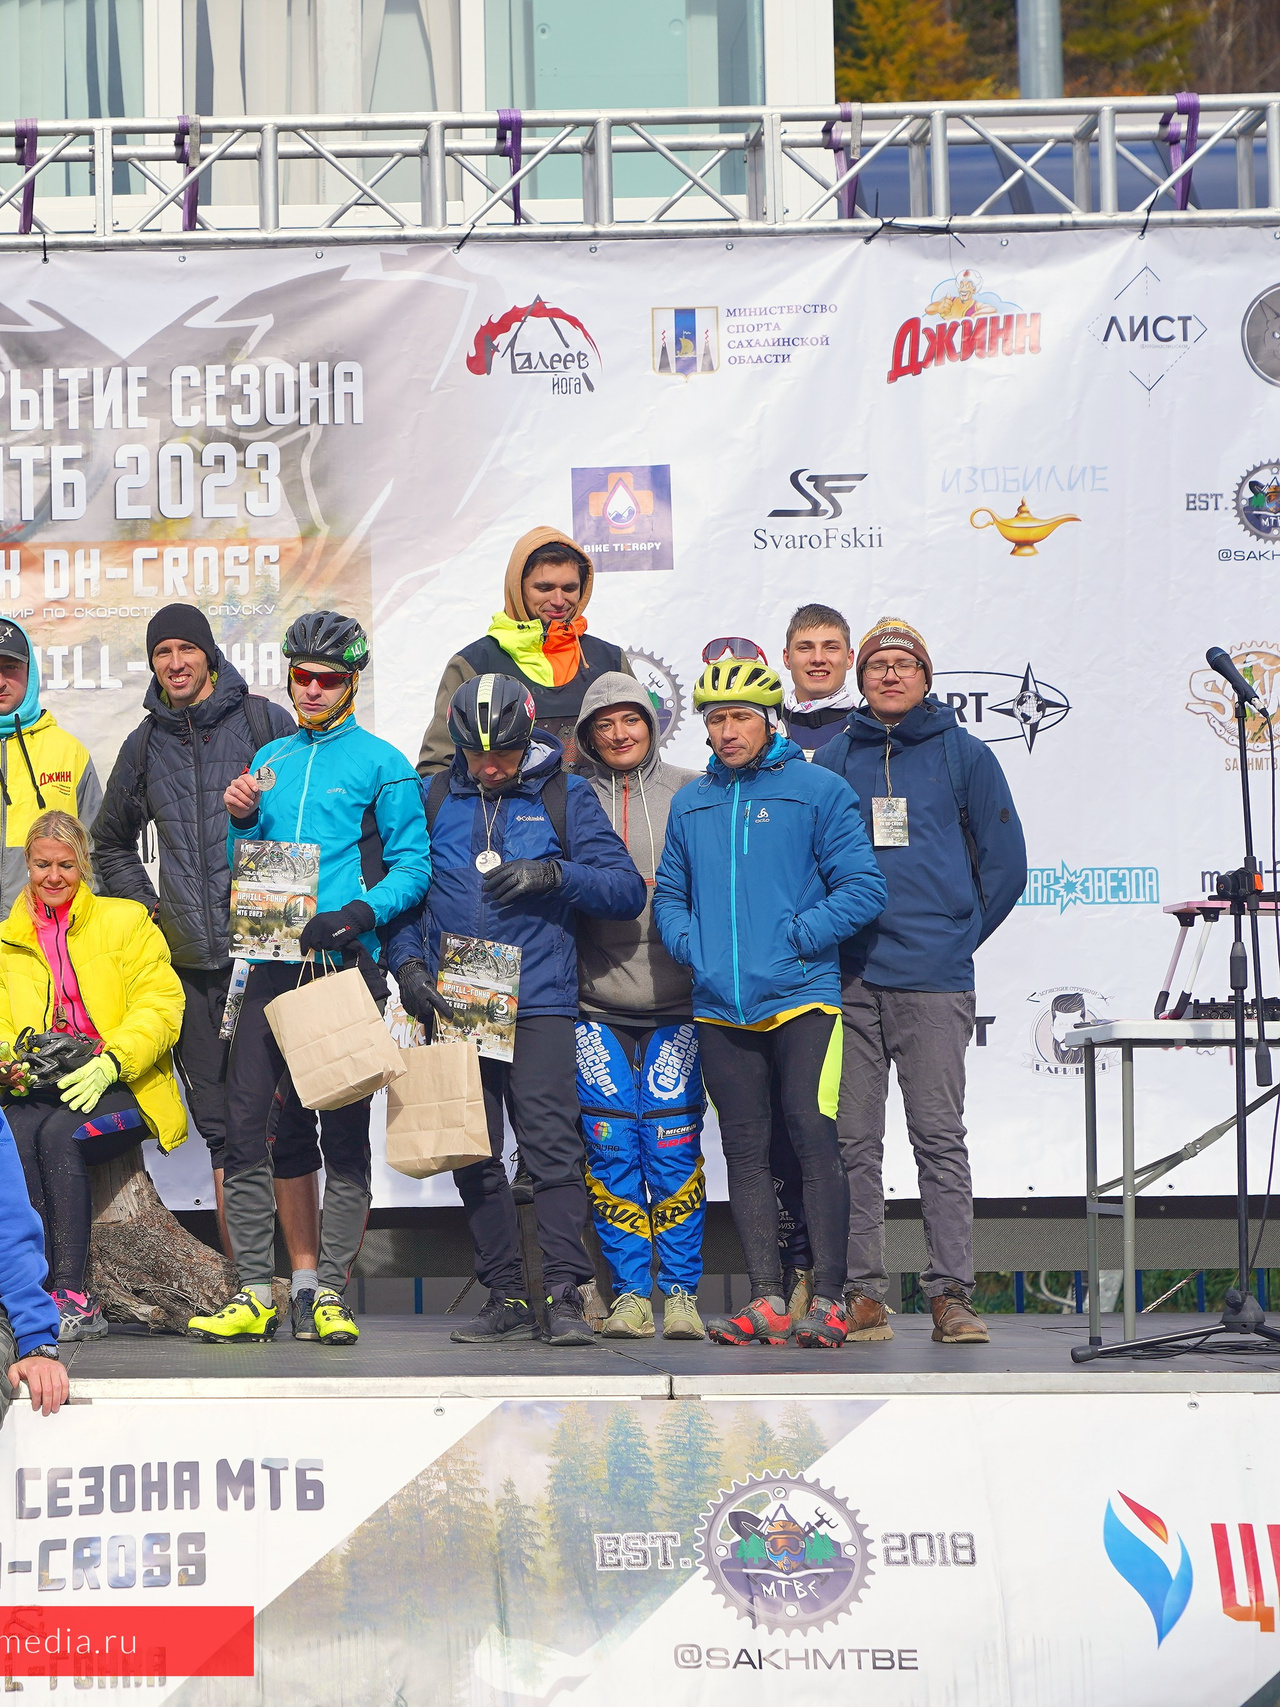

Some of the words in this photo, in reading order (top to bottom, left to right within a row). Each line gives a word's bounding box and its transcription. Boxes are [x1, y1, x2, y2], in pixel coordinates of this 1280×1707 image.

[725, 303, 838, 318] МИНИСТЕРСТВО
[727, 323, 781, 334] СПОРТА
[727, 334, 830, 347] САХАЛИНСКОЙ
[1102, 315, 1193, 342] ЛИСТ
[727, 353, 791, 366] ОБЛАСТИ
[886, 312, 1042, 384] ДЖИНН
[171, 361, 364, 428] СЕЗОНА
[115, 441, 282, 520] 2023
[940, 465, 1109, 493] ИЗОБИЛИЕ
[1185, 493, 1228, 511] EST.
[583, 544, 610, 553] BIKE
[753, 527, 883, 550] SvaroFskii
[45, 545, 281, 598] DH-CROSS
[43, 606, 66, 617] ПО
[208, 604, 275, 616] СПУСКУ
[351, 641, 362, 656] 147
[40, 771, 71, 787] ДЖИНН
[479, 855, 487, 864] 3
[1081, 868, 1158, 902] ЗВЕЗДА
[296, 896, 305, 916] 1
[495, 994, 509, 1014] 3
[575, 1024, 618, 1097] Reaction
[587, 1030, 611, 1063] Chain
[653, 1040, 673, 1073] Chain
[654, 1177, 705, 1228] MAVI
[15, 1461, 199, 1519] СЕЗОНА
[216, 1457, 326, 1512] МТБ
[594, 1531, 691, 1572] EST.
[881, 1531, 977, 1568] 2018
[1210, 1522, 1280, 1633] Ц
[673, 1643, 918, 1672] @SAKHMTBE
